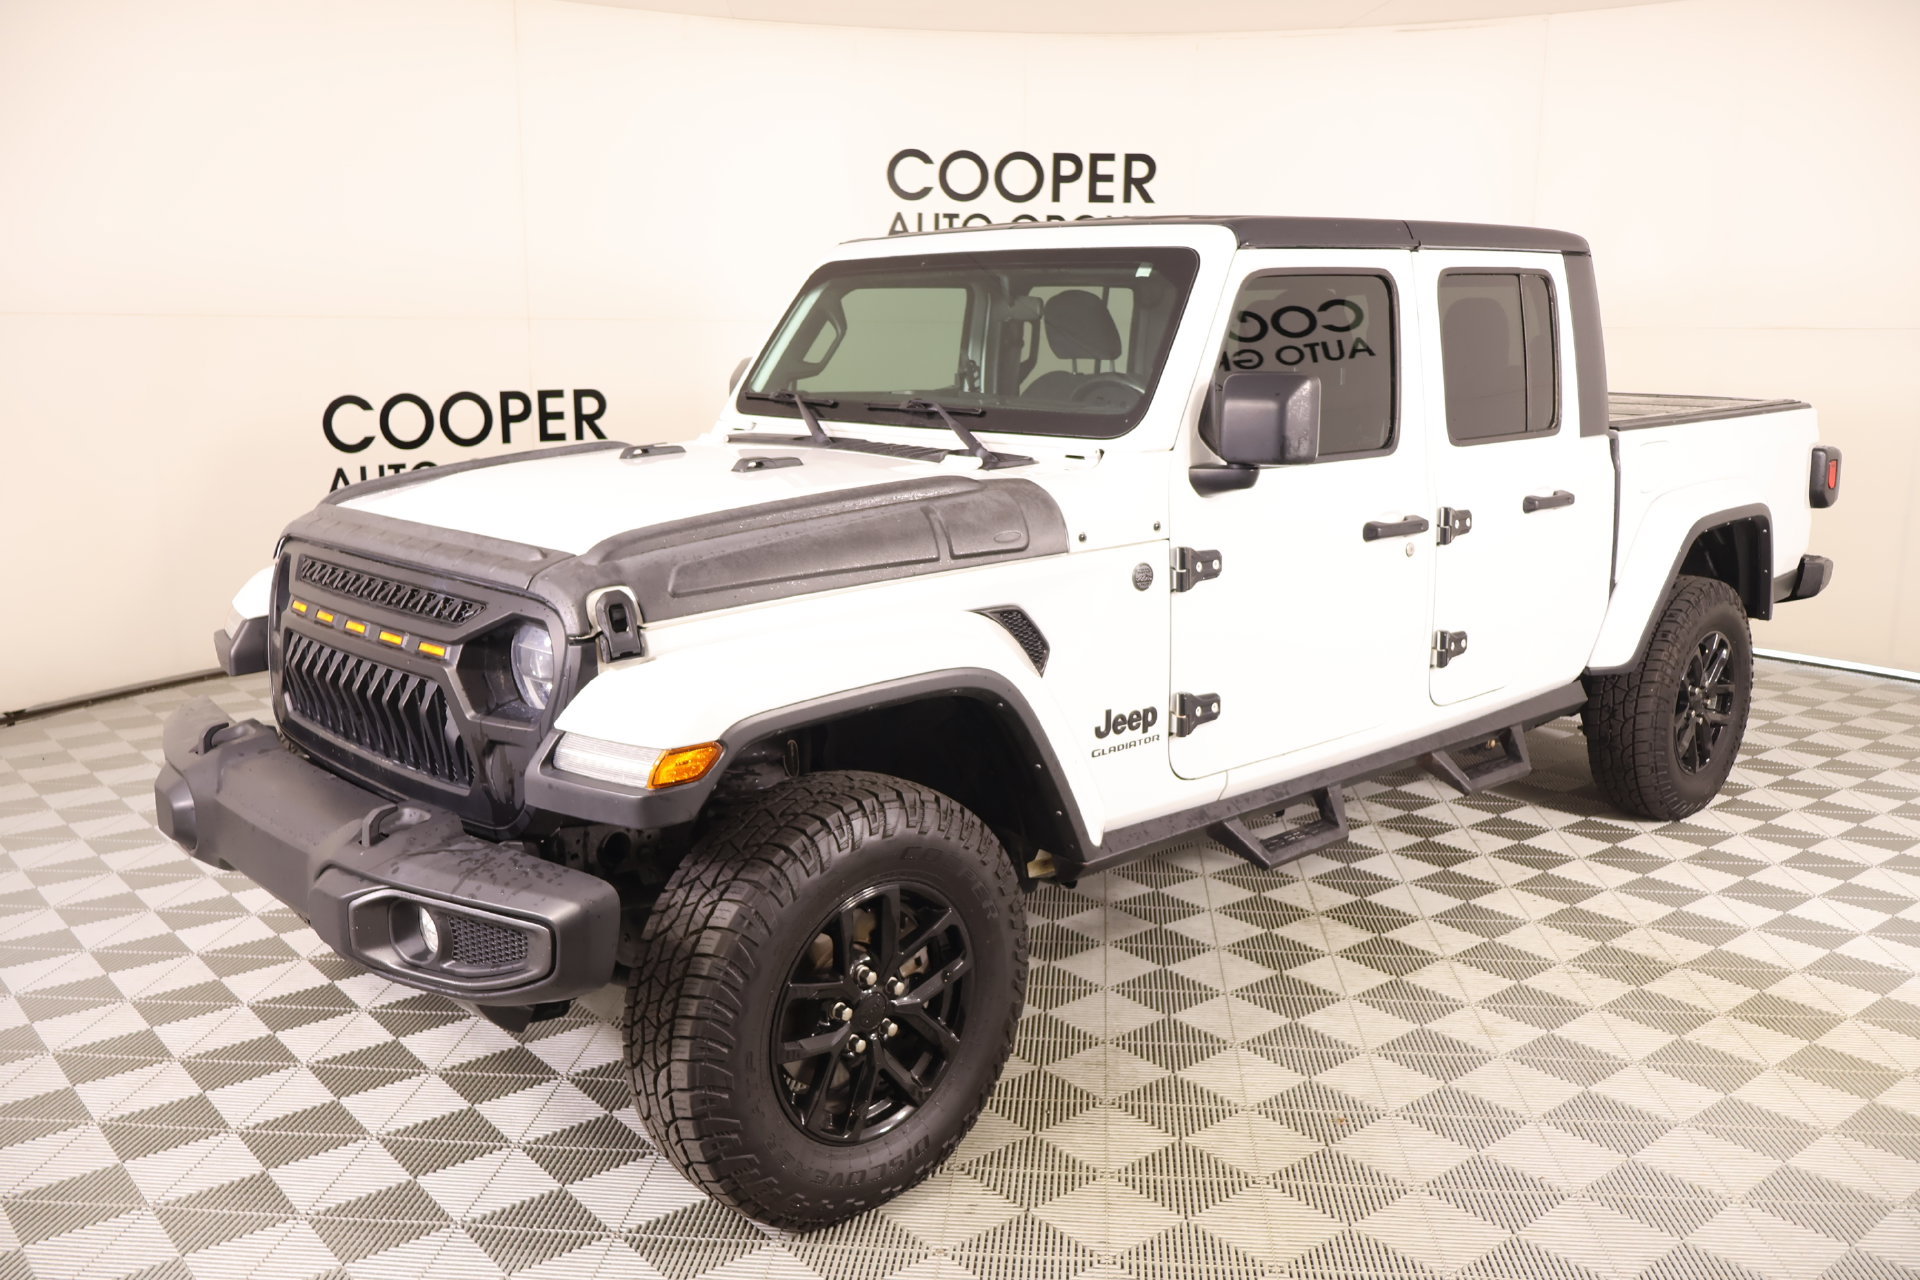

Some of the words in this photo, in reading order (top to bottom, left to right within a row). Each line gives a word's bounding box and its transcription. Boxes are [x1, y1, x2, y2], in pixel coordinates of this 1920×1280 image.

[887, 148, 1157, 203] COOPER
[322, 389, 608, 453] COOPER
[1094, 705, 1158, 739] Jeep
[1091, 734, 1160, 758] GLADIATOR
